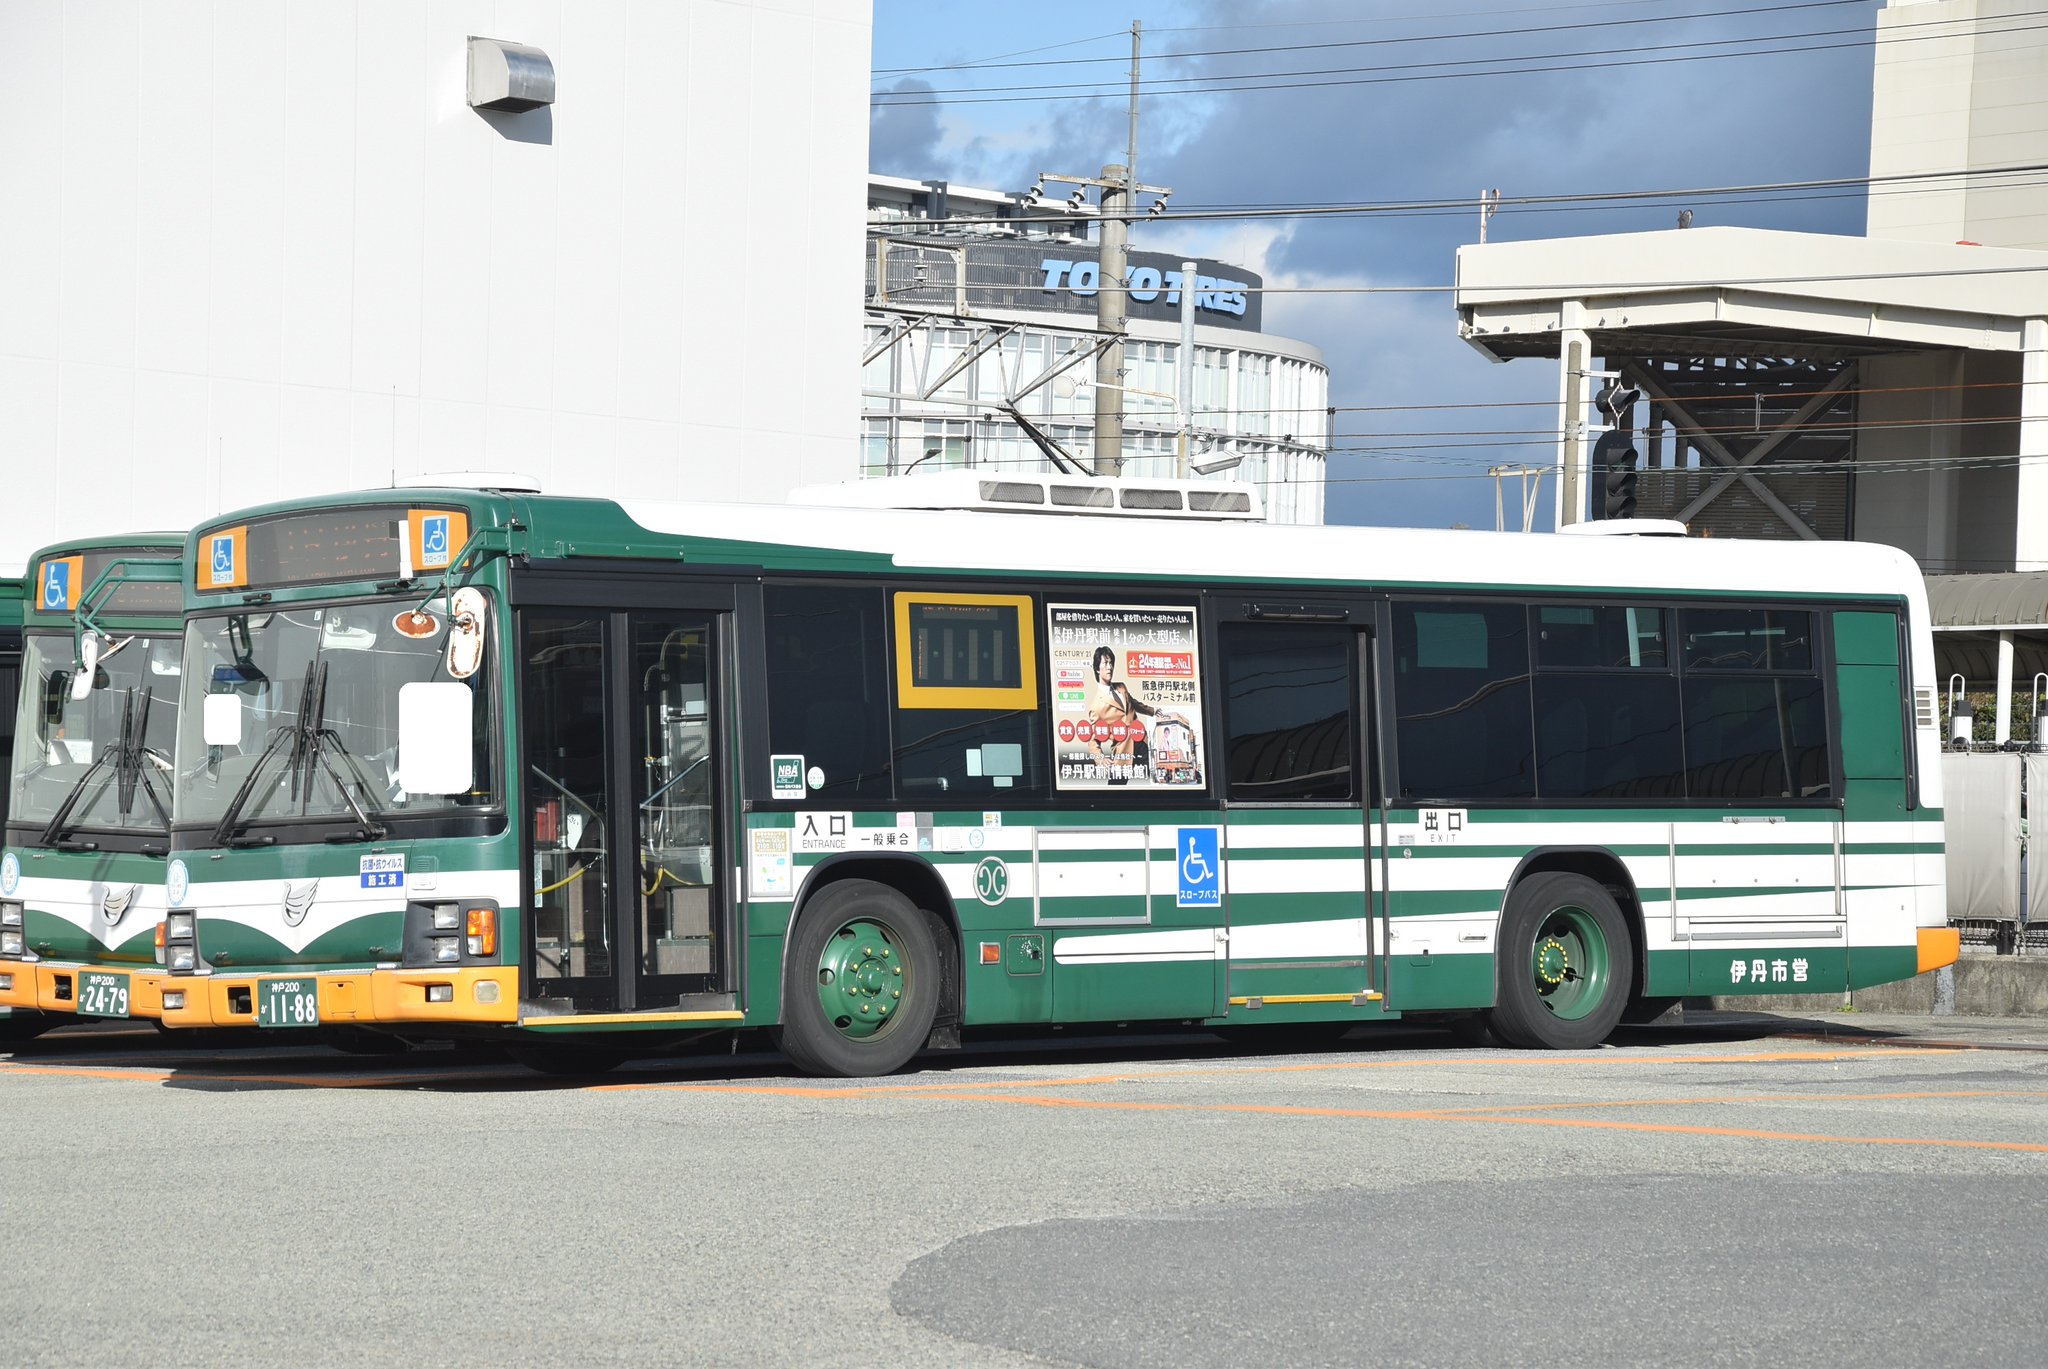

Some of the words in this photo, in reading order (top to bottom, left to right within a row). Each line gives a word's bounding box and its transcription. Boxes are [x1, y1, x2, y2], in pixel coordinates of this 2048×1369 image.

[1041, 259, 1161, 302] TOO
[1165, 271, 1249, 316] TRES
[1142, 680, 1195, 691] 阪急伊丹駅北側
[1143, 692, 1196, 703] バスターミナル前
[778, 765, 799, 777] NBA
[803, 814, 845, 836] 入口
[1425, 812, 1461, 831] 出口
[803, 839, 846, 849] ENTRANCE
[861, 832, 909, 846] 一般乗合
[1430, 834, 1456, 843] EXIT
[362, 858, 403, 870] 抗菌・抗ウイルス
[368, 873, 397, 886] 施工済
[1180, 890, 1218, 899] スロープバス
[1730, 958, 1809, 984] 伊丹市営
[85, 986, 127, 1014] 24-79
[270, 994, 316, 1023] 11-88
